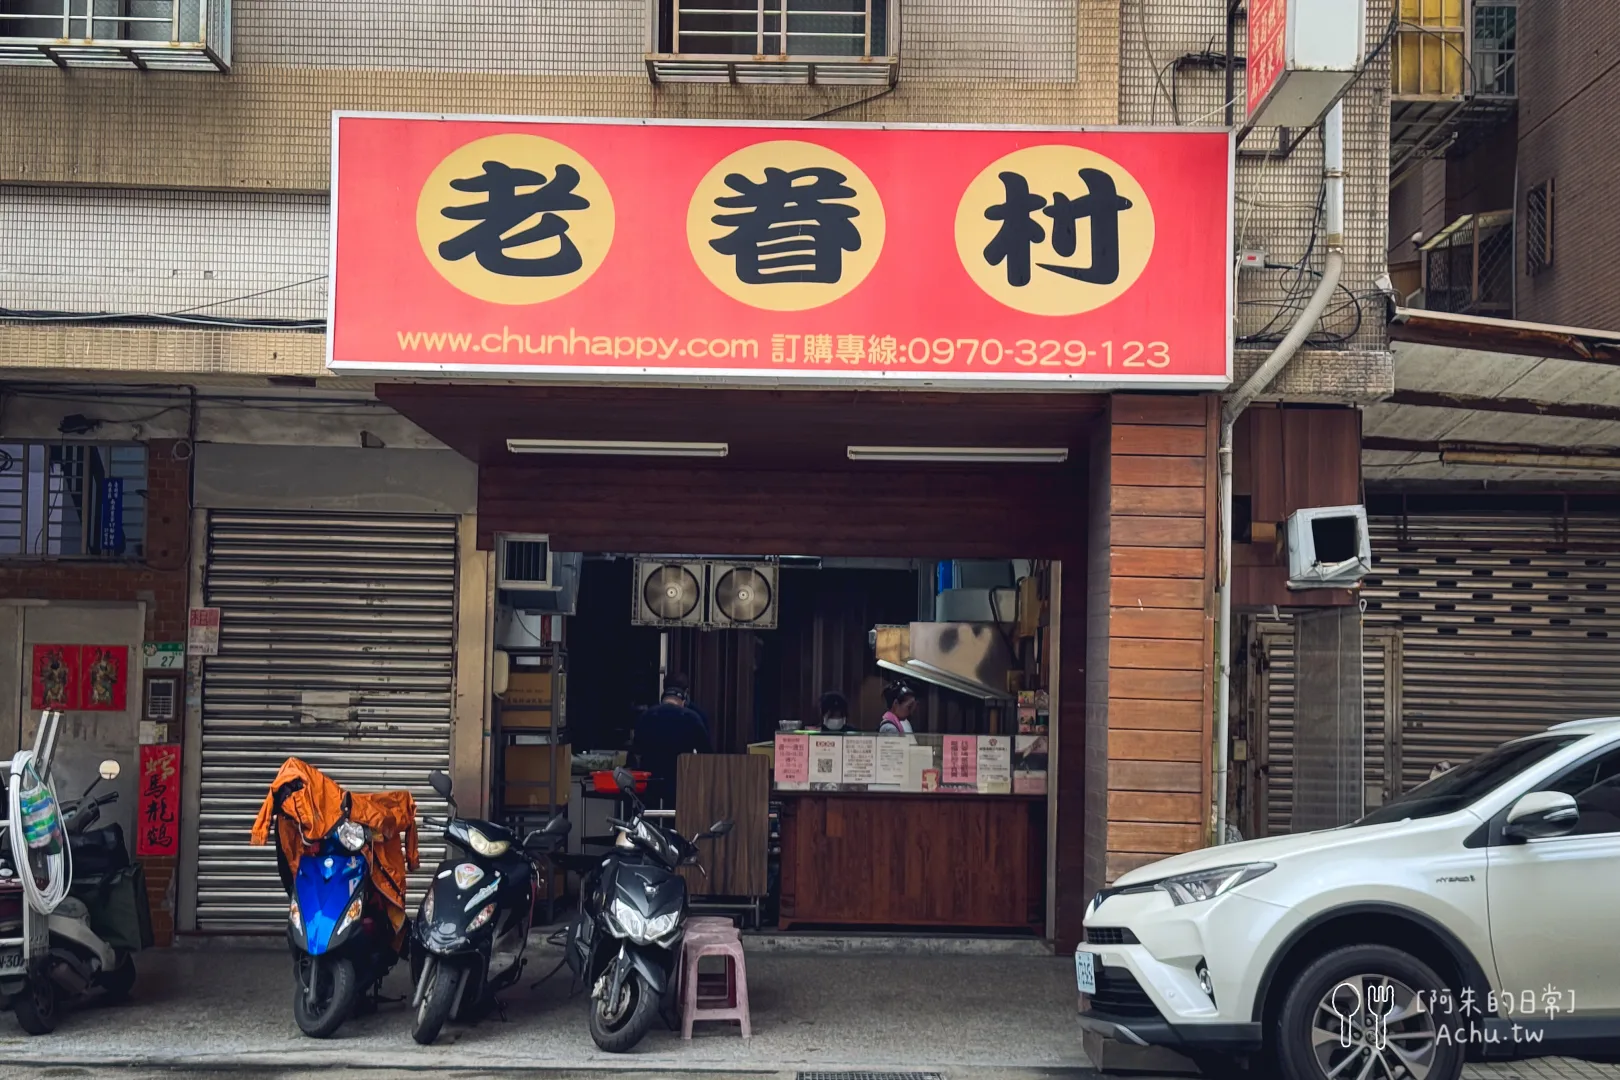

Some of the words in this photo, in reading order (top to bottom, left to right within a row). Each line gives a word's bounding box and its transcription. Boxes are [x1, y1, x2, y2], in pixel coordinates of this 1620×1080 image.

[438, 161, 1134, 287] 老眷村
[396, 325, 760, 361] www.chunhappy.com
[771, 333, 1171, 368] 訂購專線:0970-329-123
[160, 655, 176, 668] 27
